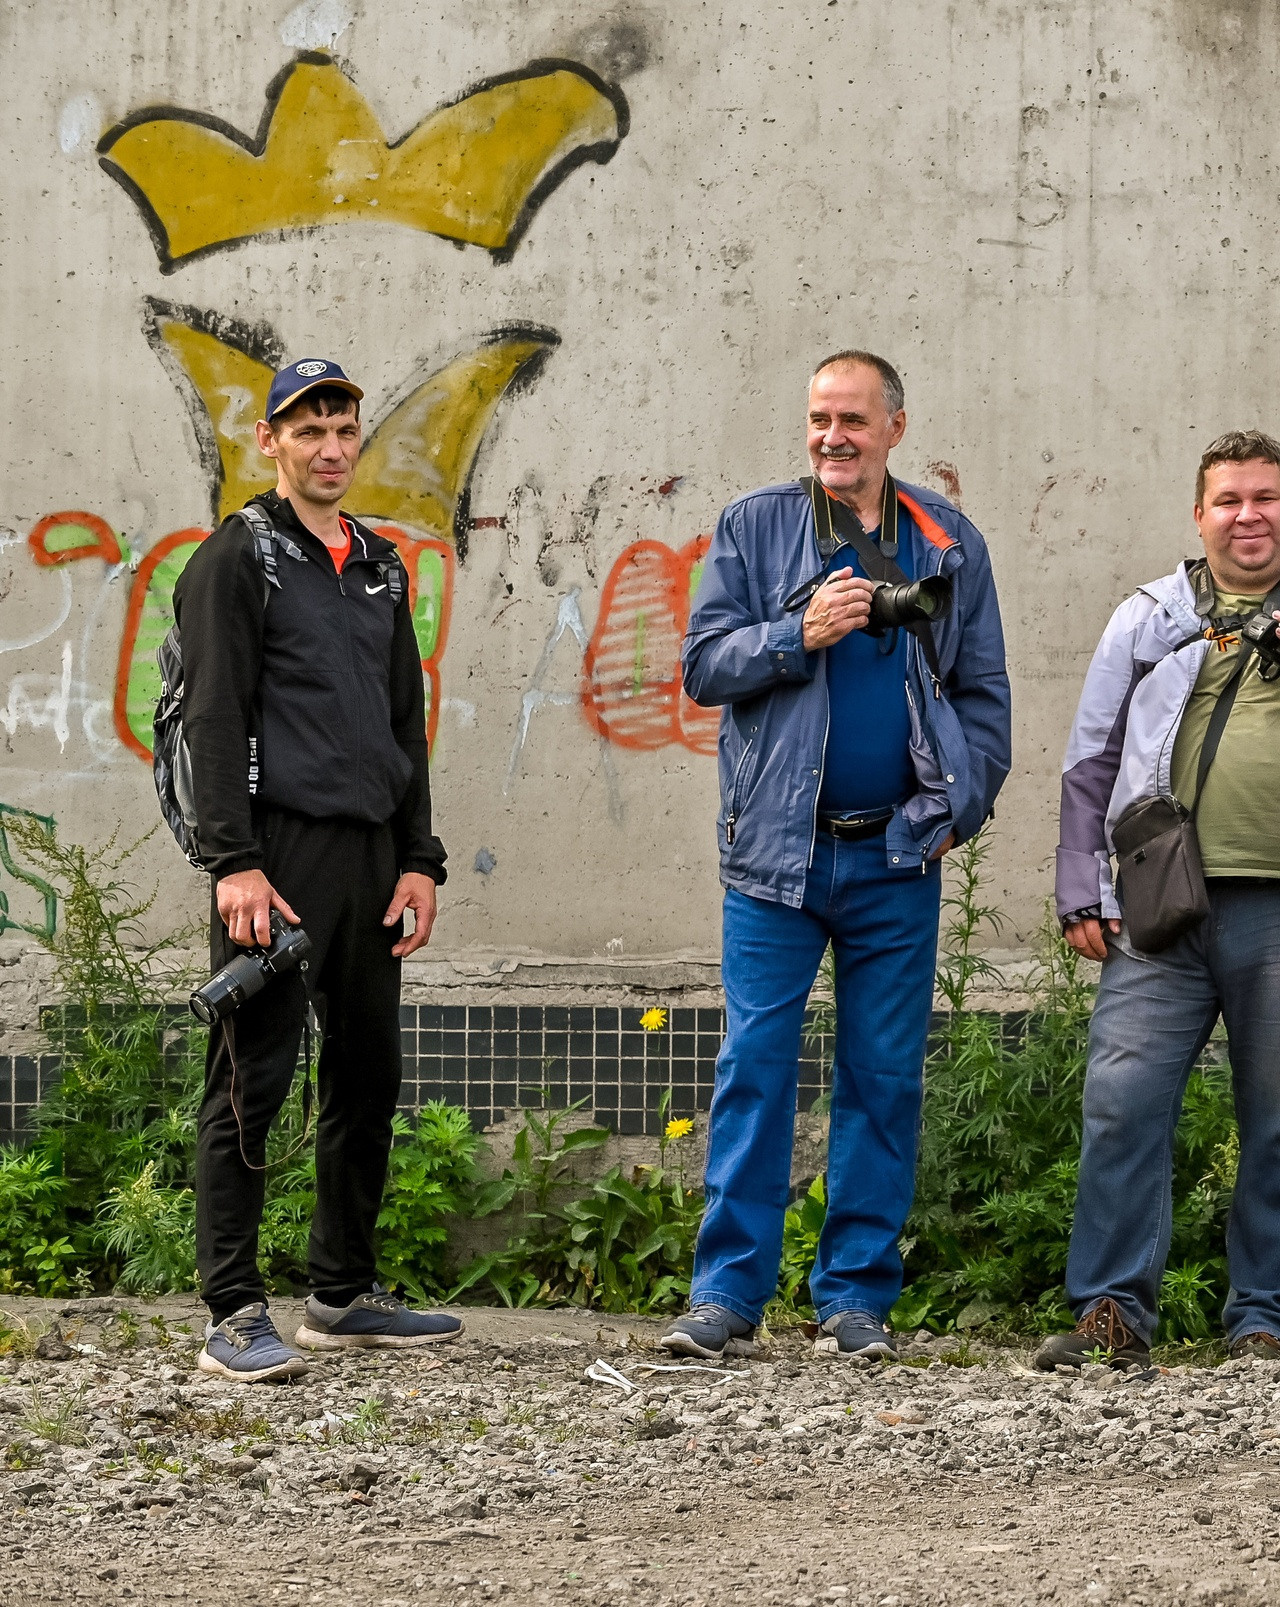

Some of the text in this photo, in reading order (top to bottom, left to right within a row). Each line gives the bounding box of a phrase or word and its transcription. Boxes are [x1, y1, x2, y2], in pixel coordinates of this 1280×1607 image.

[248, 737, 259, 795] JUST DO IT
